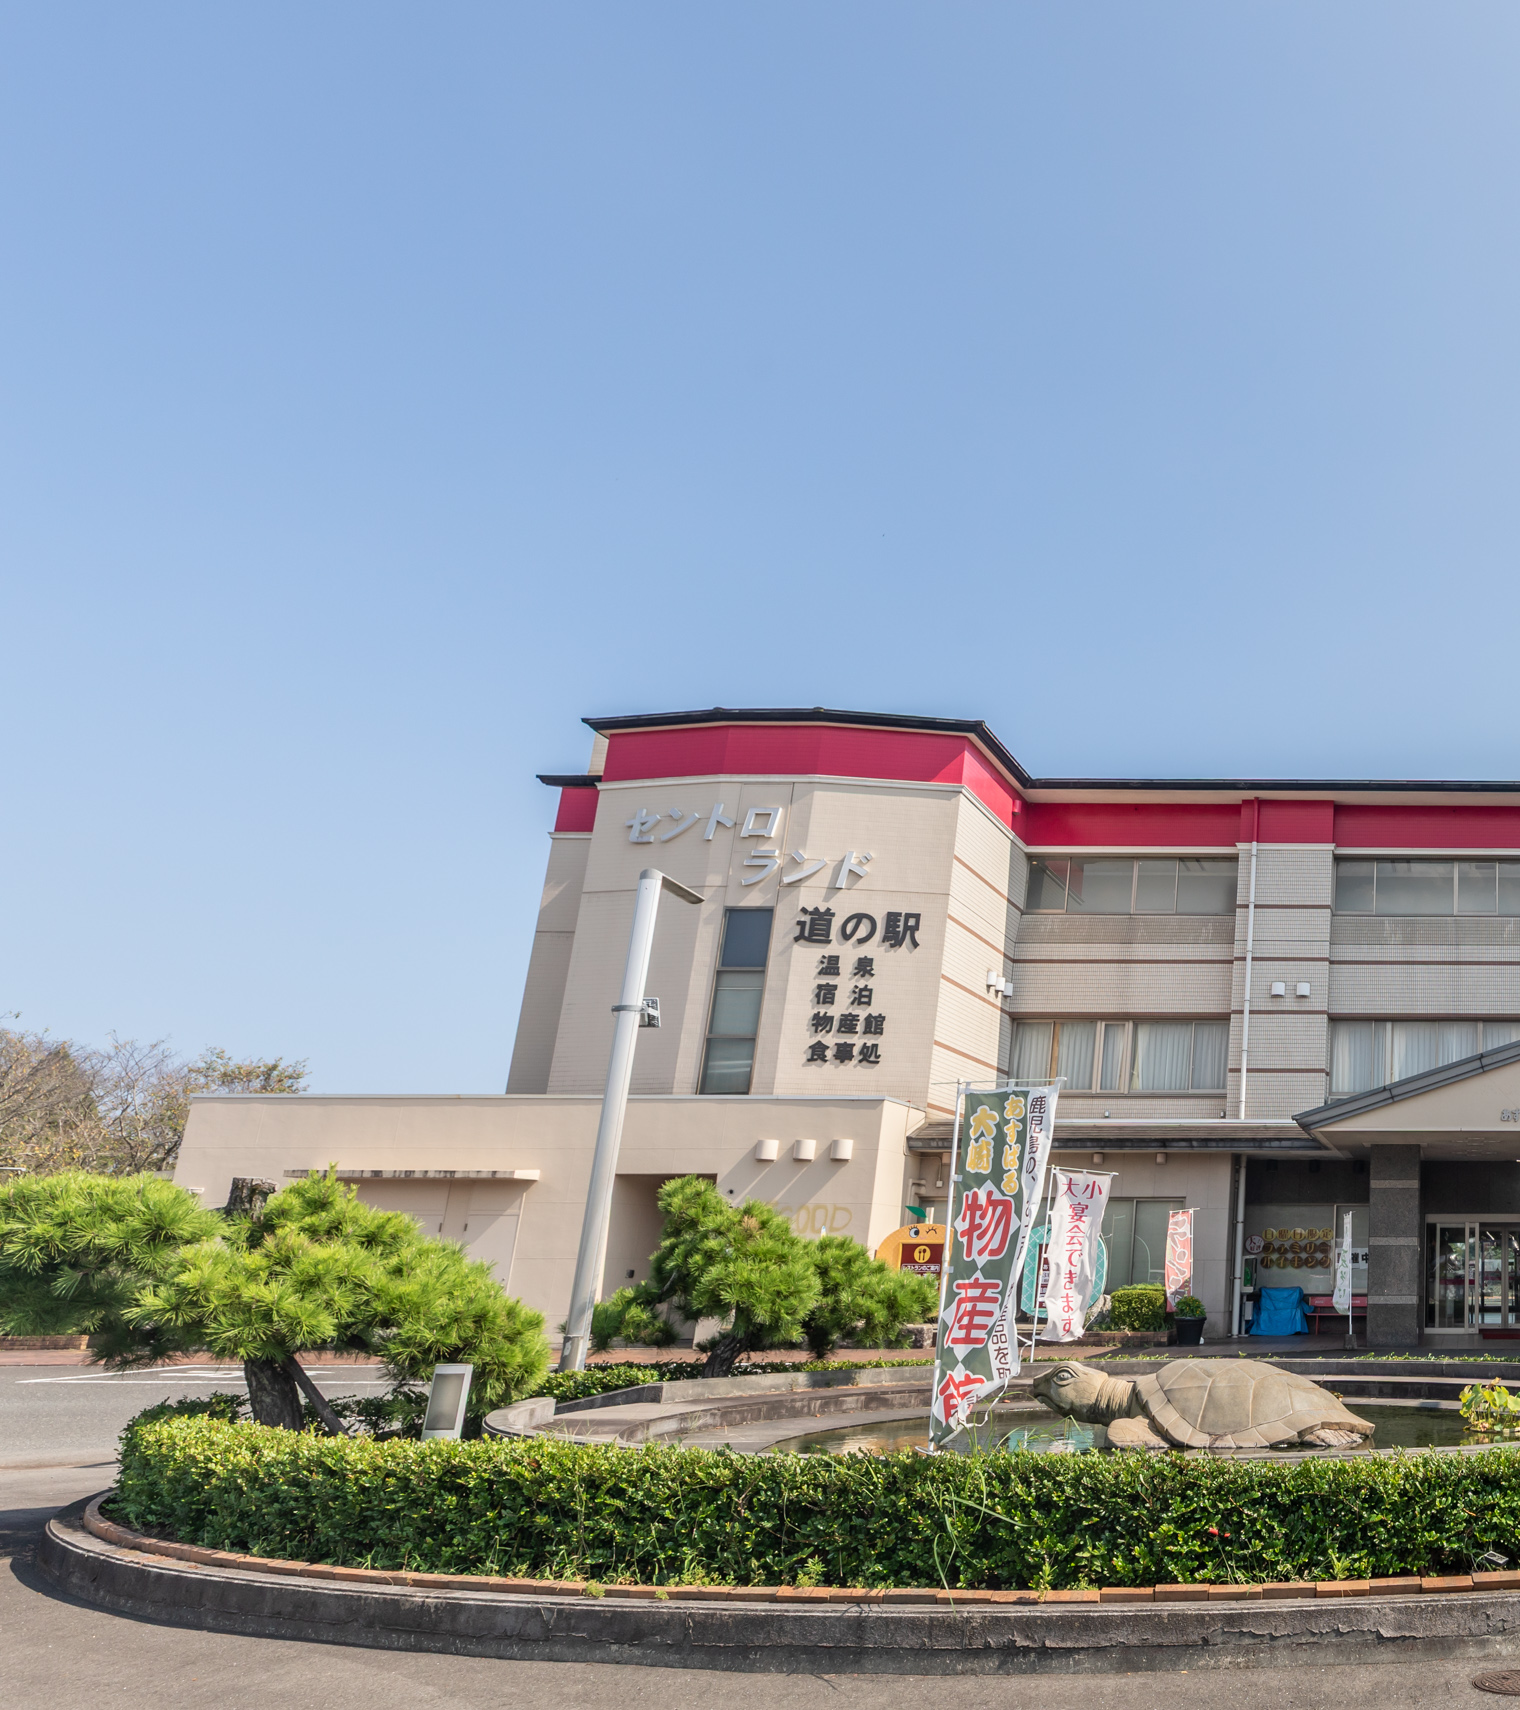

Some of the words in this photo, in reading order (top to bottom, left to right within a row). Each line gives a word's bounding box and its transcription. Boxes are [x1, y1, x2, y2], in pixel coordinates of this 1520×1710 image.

[625, 803, 784, 844] セントロ
[740, 849, 874, 889] ランド
[794, 906, 921, 949] 道の駅
[817, 954, 876, 978] 温泉
[815, 983, 874, 1007] 宿泊
[811, 1012, 886, 1037] 物産館
[806, 1041, 881, 1065] 食事処
[966, 1106, 999, 1173] 大崎
[1001, 1096, 1025, 1194] あすばる
[781, 1204, 853, 1235] OOD
[1263, 1228, 1333, 1240] 日曜日限定
[1061, 1202, 1089, 1337] 宴会できます
